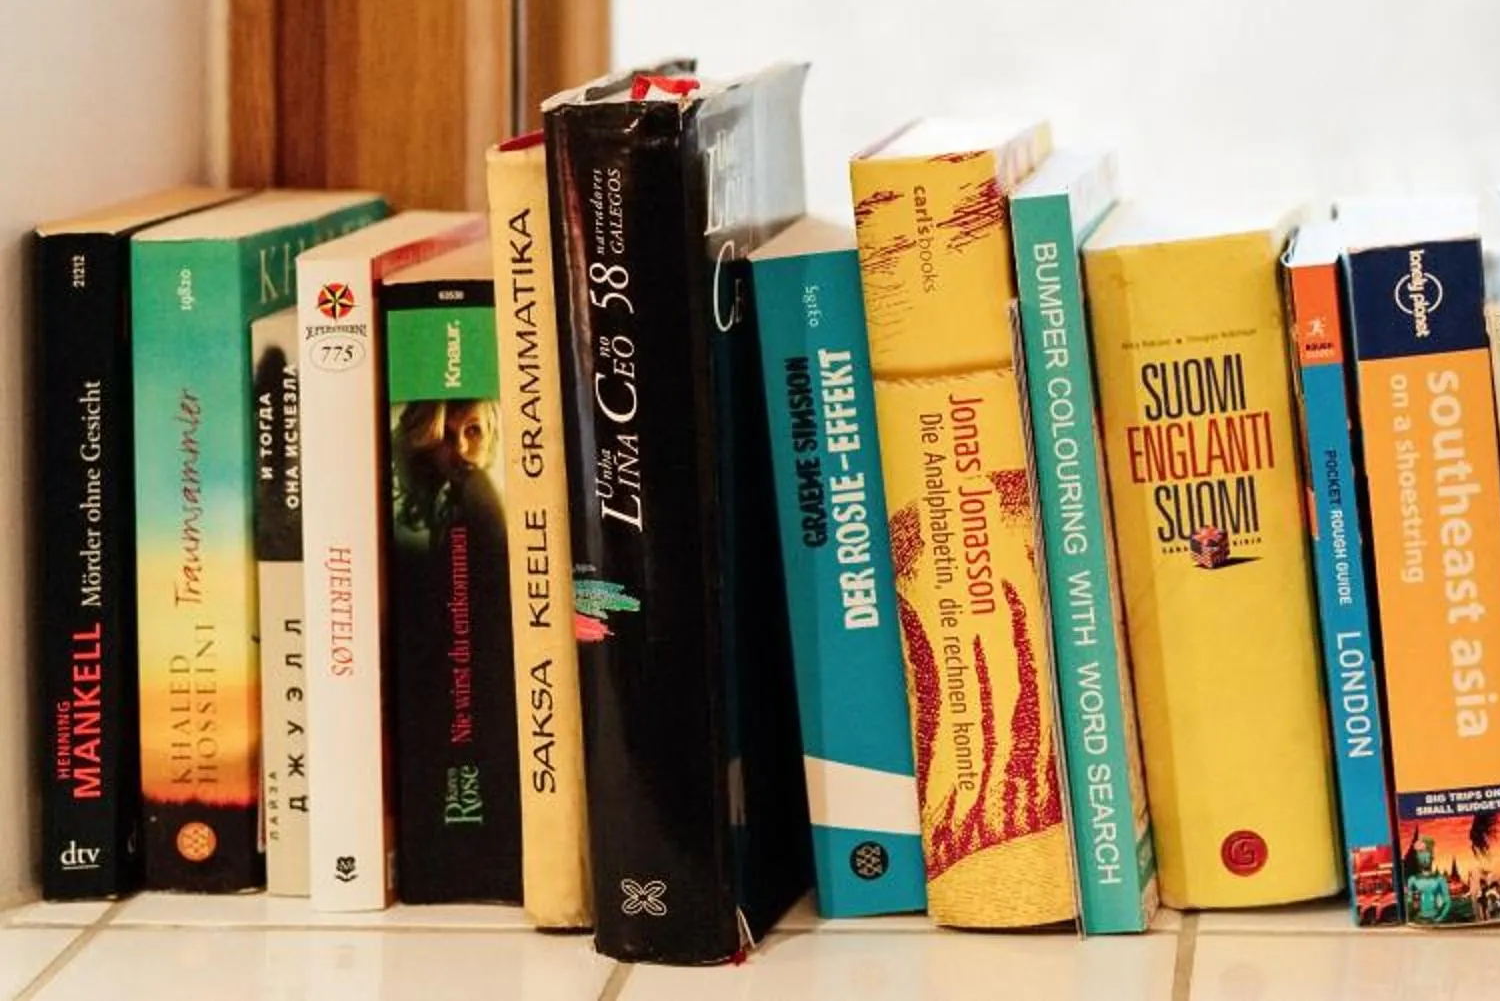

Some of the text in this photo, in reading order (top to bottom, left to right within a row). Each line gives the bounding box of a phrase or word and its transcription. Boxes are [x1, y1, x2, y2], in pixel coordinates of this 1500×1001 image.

[593, 168, 605, 256] narradores
[608, 167, 626, 256] GALEGOS
[73, 254, 86, 288] 21212
[176, 268, 193, 311] 19820
[589, 261, 636, 314] 58
[803, 284, 821, 328] 03185
[1408, 248, 1431, 339] lonely planet
[321, 345, 355, 363] 775
[445, 320, 462, 389] Knaur.
[1140, 353, 1248, 422] SUOMI
[259, 392, 273, 480] И ТОГДА
[283, 363, 299, 510] ОНА ИСЧЕЗЛА
[595, 449, 615, 500] Unha
[784, 356, 828, 549] GRAEME SIMSION
[1126, 411, 1276, 485] ENGLANTI
[1389, 373, 1428, 584] on a shoestring
[79, 379, 102, 608] Mörder ohne Gesicht
[174, 388, 203, 608] Traumsammler
[508, 207, 557, 794] SAKSA KEELE GRAMMATIKA
[948, 392, 997, 617] Jonas Jonasson
[1153, 475, 1261, 544] SUOMI
[1323, 449, 1353, 606] POCKET ROUGH GUIDE
[836, 565, 881, 631] DER
[1032, 241, 1122, 885] BUMPER COLOURING WITH WORD SEARCH
[1426, 370, 1499, 739] southeast asia
[327, 547, 354, 677] HJERTELØS
[447, 526, 473, 743] Nie wirst du entkommen
[918, 412, 976, 792] Die Analphabetin, die rechnen konnte
[73, 622, 101, 799] MANKELL
[169, 654, 192, 785] KHALED
[195, 624, 218, 785] HOSSEINI
[285, 618, 309, 813] ДЖУЭЛЛ
[1336, 630, 1375, 759] LONDON
[56, 700, 71, 780] HENNING
[444, 764, 484, 825] Rose
[1415, 803, 1455, 817] SMALL
[1425, 791, 1448, 805] BIG
[1449, 789, 1483, 802] TRIPS
[60, 840, 100, 866] dtv
